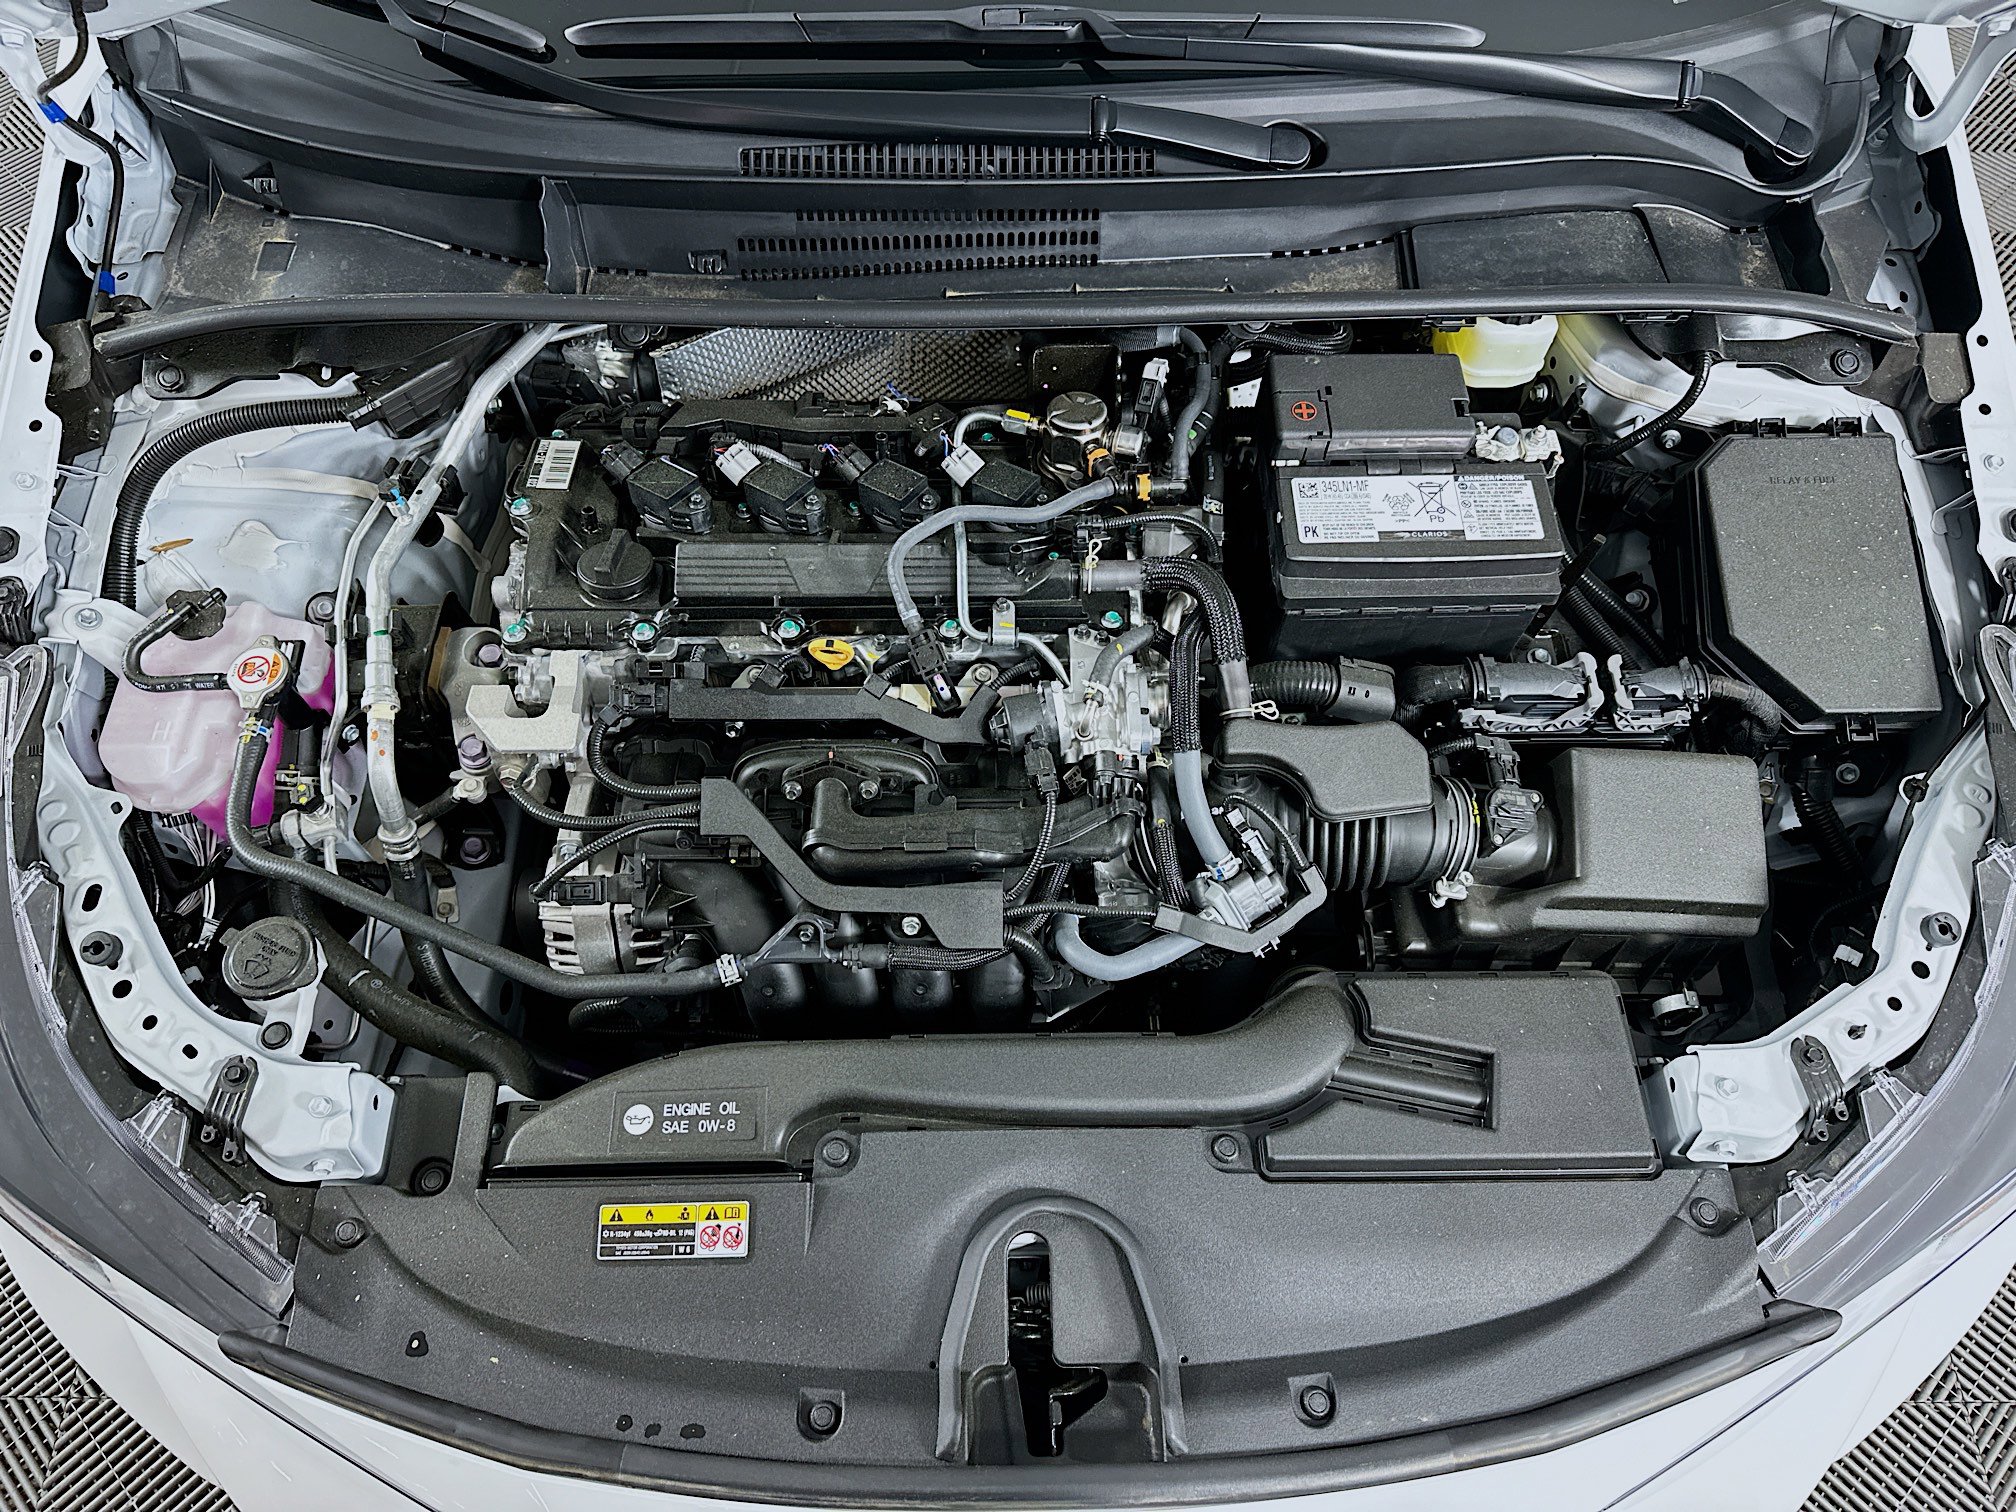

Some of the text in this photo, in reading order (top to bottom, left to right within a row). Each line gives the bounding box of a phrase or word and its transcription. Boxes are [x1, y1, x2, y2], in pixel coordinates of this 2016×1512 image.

[1321, 480, 1369, 493] 345LN1-MF
[1429, 515, 1445, 523] Pb
[1304, 525, 1319, 538] PK
[663, 1101, 740, 1117] ENGINE OIL
[662, 1119, 736, 1134] SAE 0W-8
